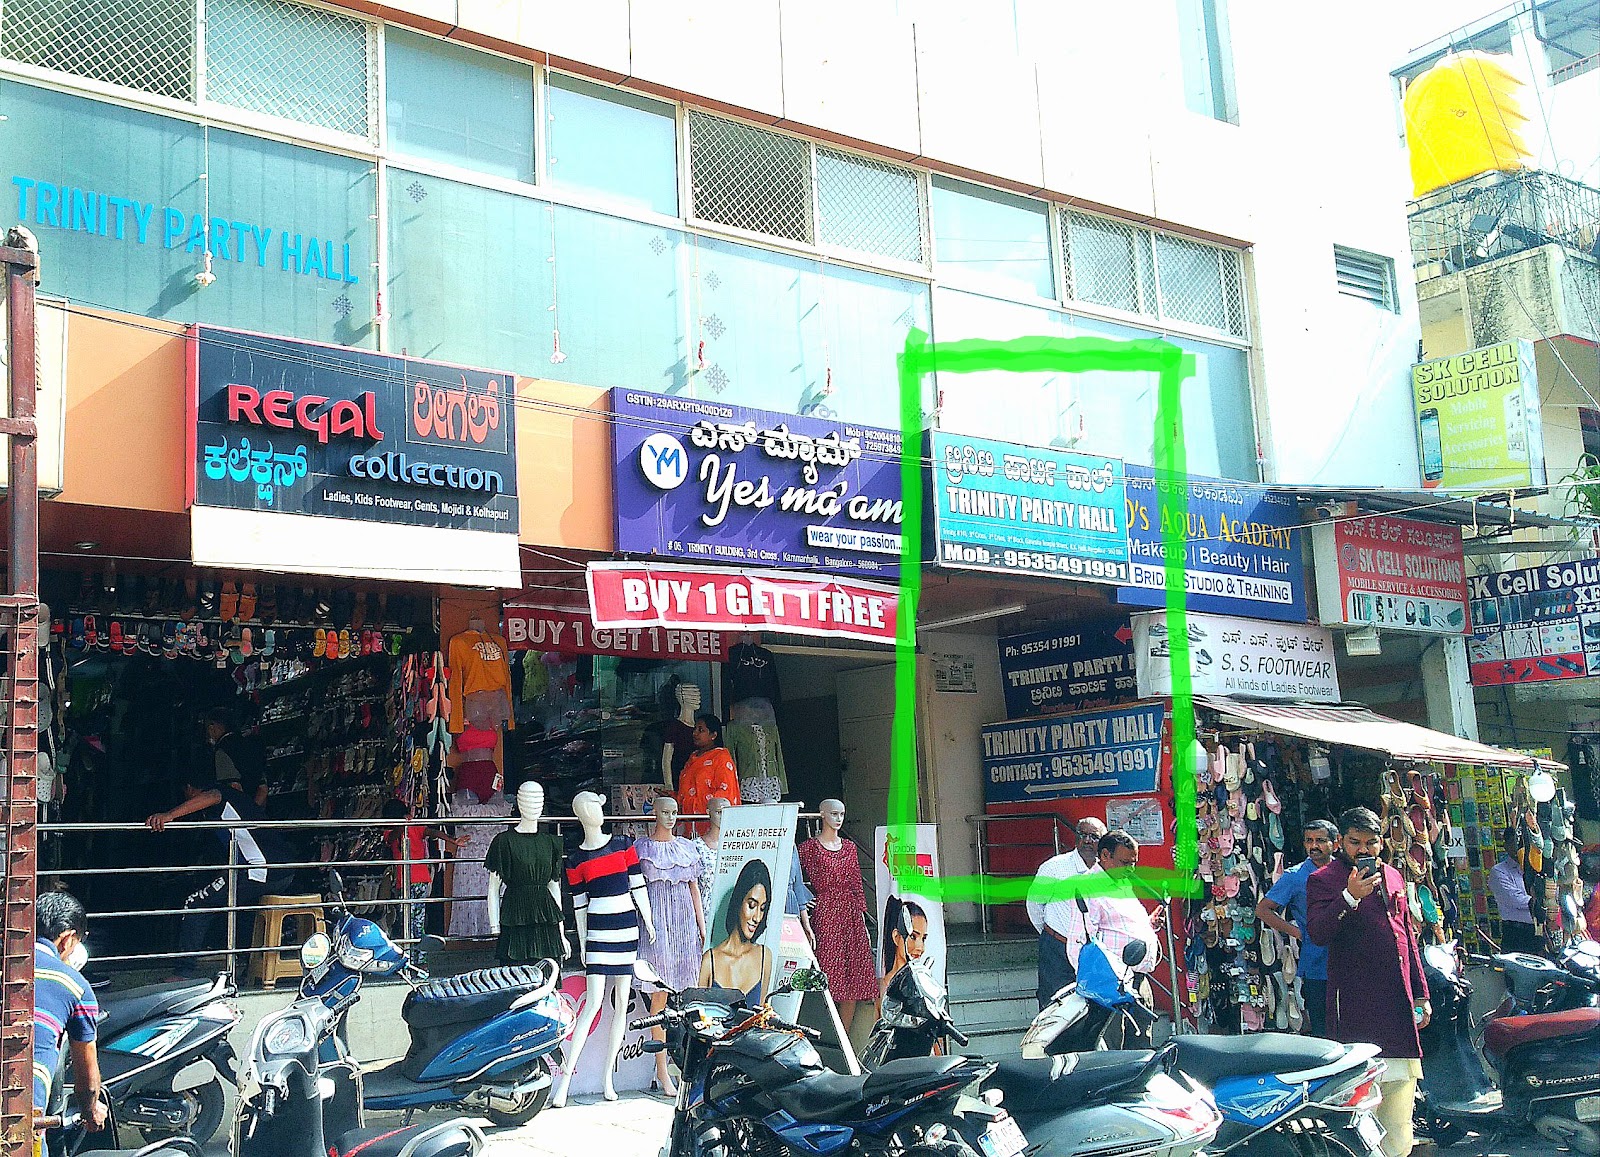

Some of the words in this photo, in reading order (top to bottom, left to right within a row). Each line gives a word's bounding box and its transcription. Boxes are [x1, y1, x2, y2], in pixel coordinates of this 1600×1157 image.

[12, 176, 154, 244] TRINITY
[164, 206, 272, 267] PARTY
[282, 231, 359, 284] HALL
[1416, 359, 1452, 384] SK
[1456, 344, 1517, 375] CELL
[1418, 365, 1520, 404] SOLUTION
[1450, 400, 1487, 415] Mobile
[1446, 417, 1496, 435] Servicing
[323, 489, 353, 505] Ladies,
[354, 492, 374, 507] Kids
[374, 495, 413, 512] Footwear,
[414, 499, 440, 515] Gents,
[465, 504, 472, 516] &
[700, 454, 774, 526] Yes
[946, 486, 1017, 520] TRINITY
[1021, 496, 1075, 528] PARTY
[1078, 504, 1118, 533] HALL
[687, 543, 712, 555] TRINITY
[747, 548, 757, 559] 3rd
[811, 530, 834, 543] wear
[836, 533, 857, 547] your
[944, 544, 990, 564] Mob
[1004, 550, 1126, 579] 9535491991
[1128, 538, 1187, 563] Makeup
[1200, 547, 1250, 573] Beauty
[1261, 555, 1290, 574] Hair
[1359, 548, 1375, 573] SK
[1376, 550, 1403, 576] CELL
[1405, 554, 1461, 584] SOLUTIONS
[1227, 578, 1236, 595] &
[1237, 579, 1289, 600] TRAINING
[1347, 577, 1376, 590] MOBILE
[1379, 580, 1408, 594] SERVICE
[1410, 584, 1415, 594] &
[1416, 585, 1462, 599] ACCESSORIES
[1497, 569, 1540, 595] Cell
[623, 578, 692, 615] BUY
[699, 582, 718, 615] 1
[725, 583, 788, 617] GET
[793, 586, 811, 620] 1
[817, 590, 886, 629] FREE
[1531, 616, 1579, 628] Accepted
[508, 618, 565, 645] BUY
[572, 622, 584, 647] 1
[591, 628, 642, 651] GET
[649, 629, 661, 652] 1
[667, 631, 721, 655] FREE
[1005, 646, 1019, 657] Ph:
[1008, 663, 1068, 687] TRINITY
[1073, 655, 1123, 678] PARTY
[1222, 653, 1234, 672] S.
[1240, 655, 1252, 673] S.
[1258, 657, 1331, 679] FOOTWEAR
[1225, 677, 1236, 689] All
[1237, 678, 1259, 691] kinds
[1261, 680, 1268, 691] of
[1271, 681, 1296, 694] Ladies
[1299, 683, 1333, 696] Footwear
[982, 726, 1047, 757] TRINITY
[1051, 719, 1107, 750] PARTY
[1112, 713, 1157, 744] HALL
[991, 762, 1042, 783] CONTACT
[1051, 747, 1153, 778] 9535491991
[722, 841, 758, 850] EVERYDAY
[723, 829, 735, 838] AN
[758, 828, 788, 837] BREEZY
